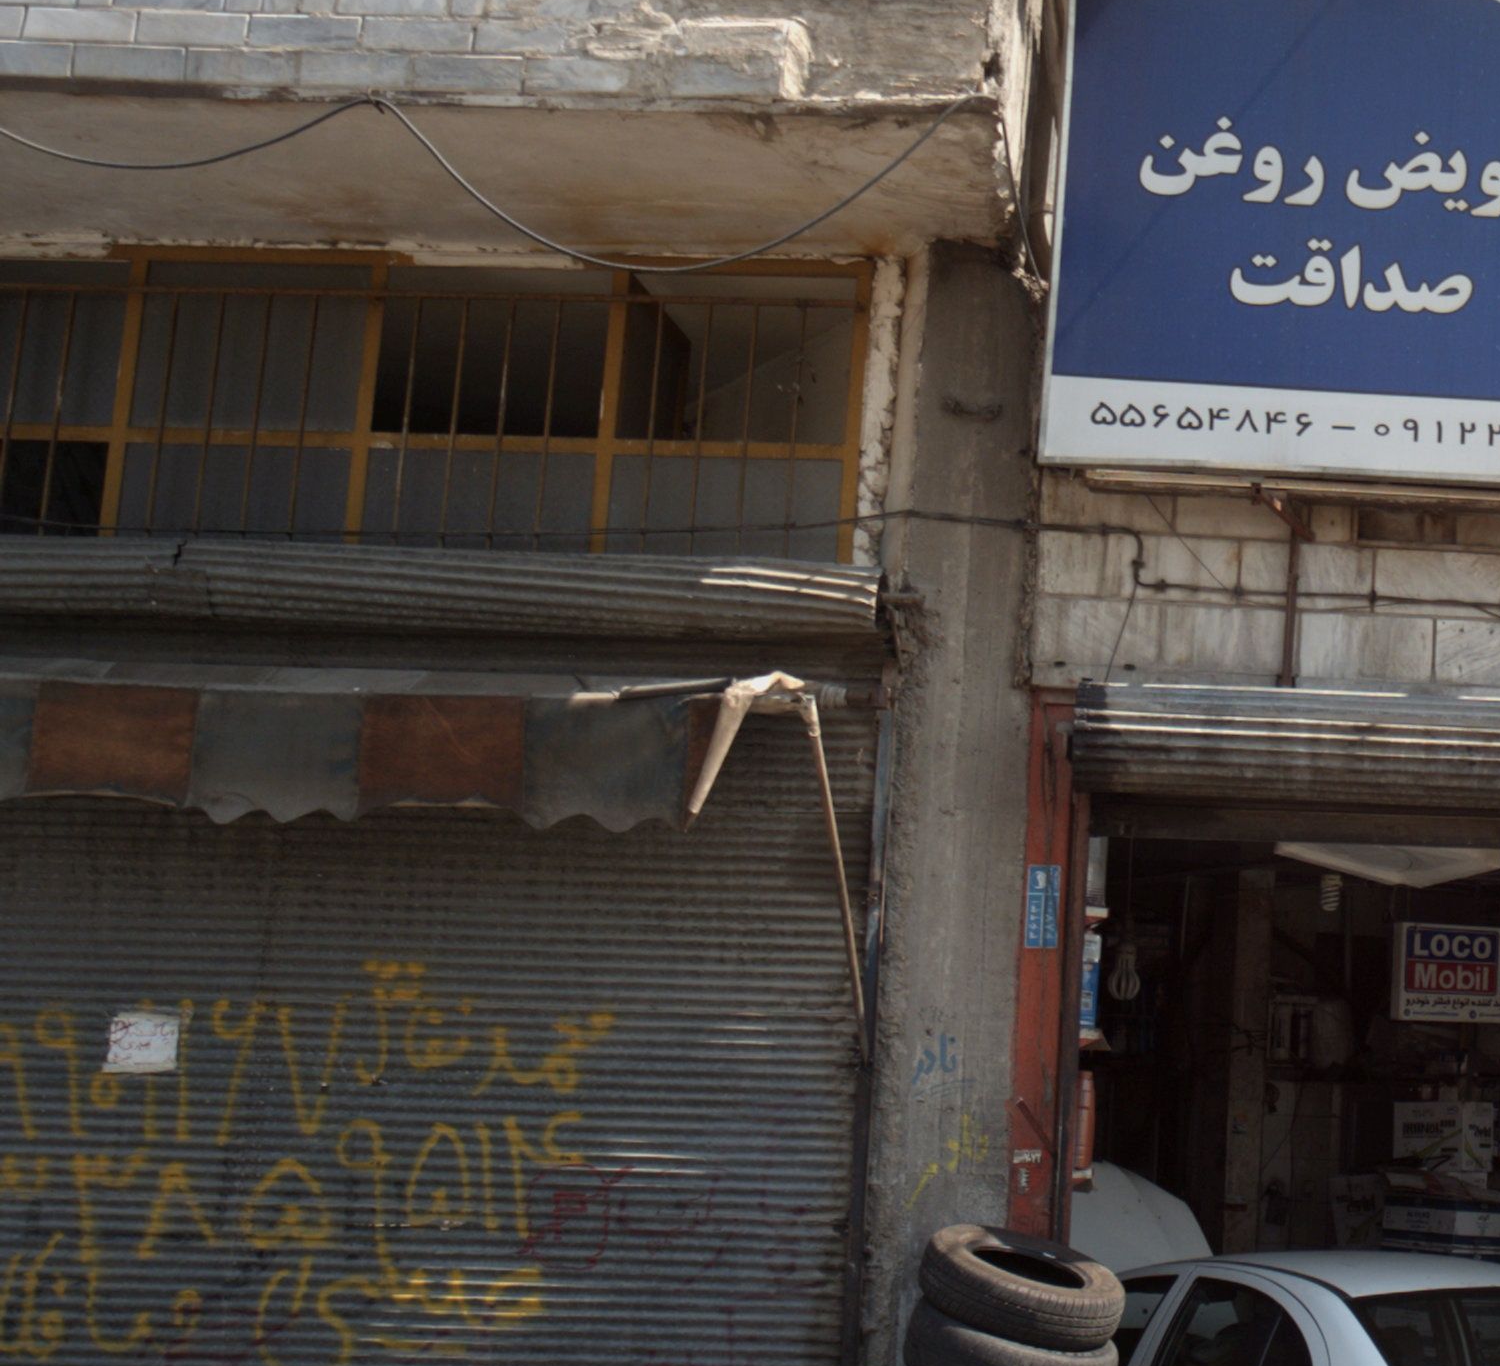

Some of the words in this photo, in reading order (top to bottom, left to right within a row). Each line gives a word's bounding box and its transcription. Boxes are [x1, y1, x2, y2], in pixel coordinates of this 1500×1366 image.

[1138, 115, 1325, 207] روغن
[1229, 236, 1474, 315] صداقت
[1089, 401, 1314, 437] ۵۵۶۵۴۸۴۶
[1412, 932, 1493, 960] LOCO
[1413, 962, 1491, 991] Mobil
